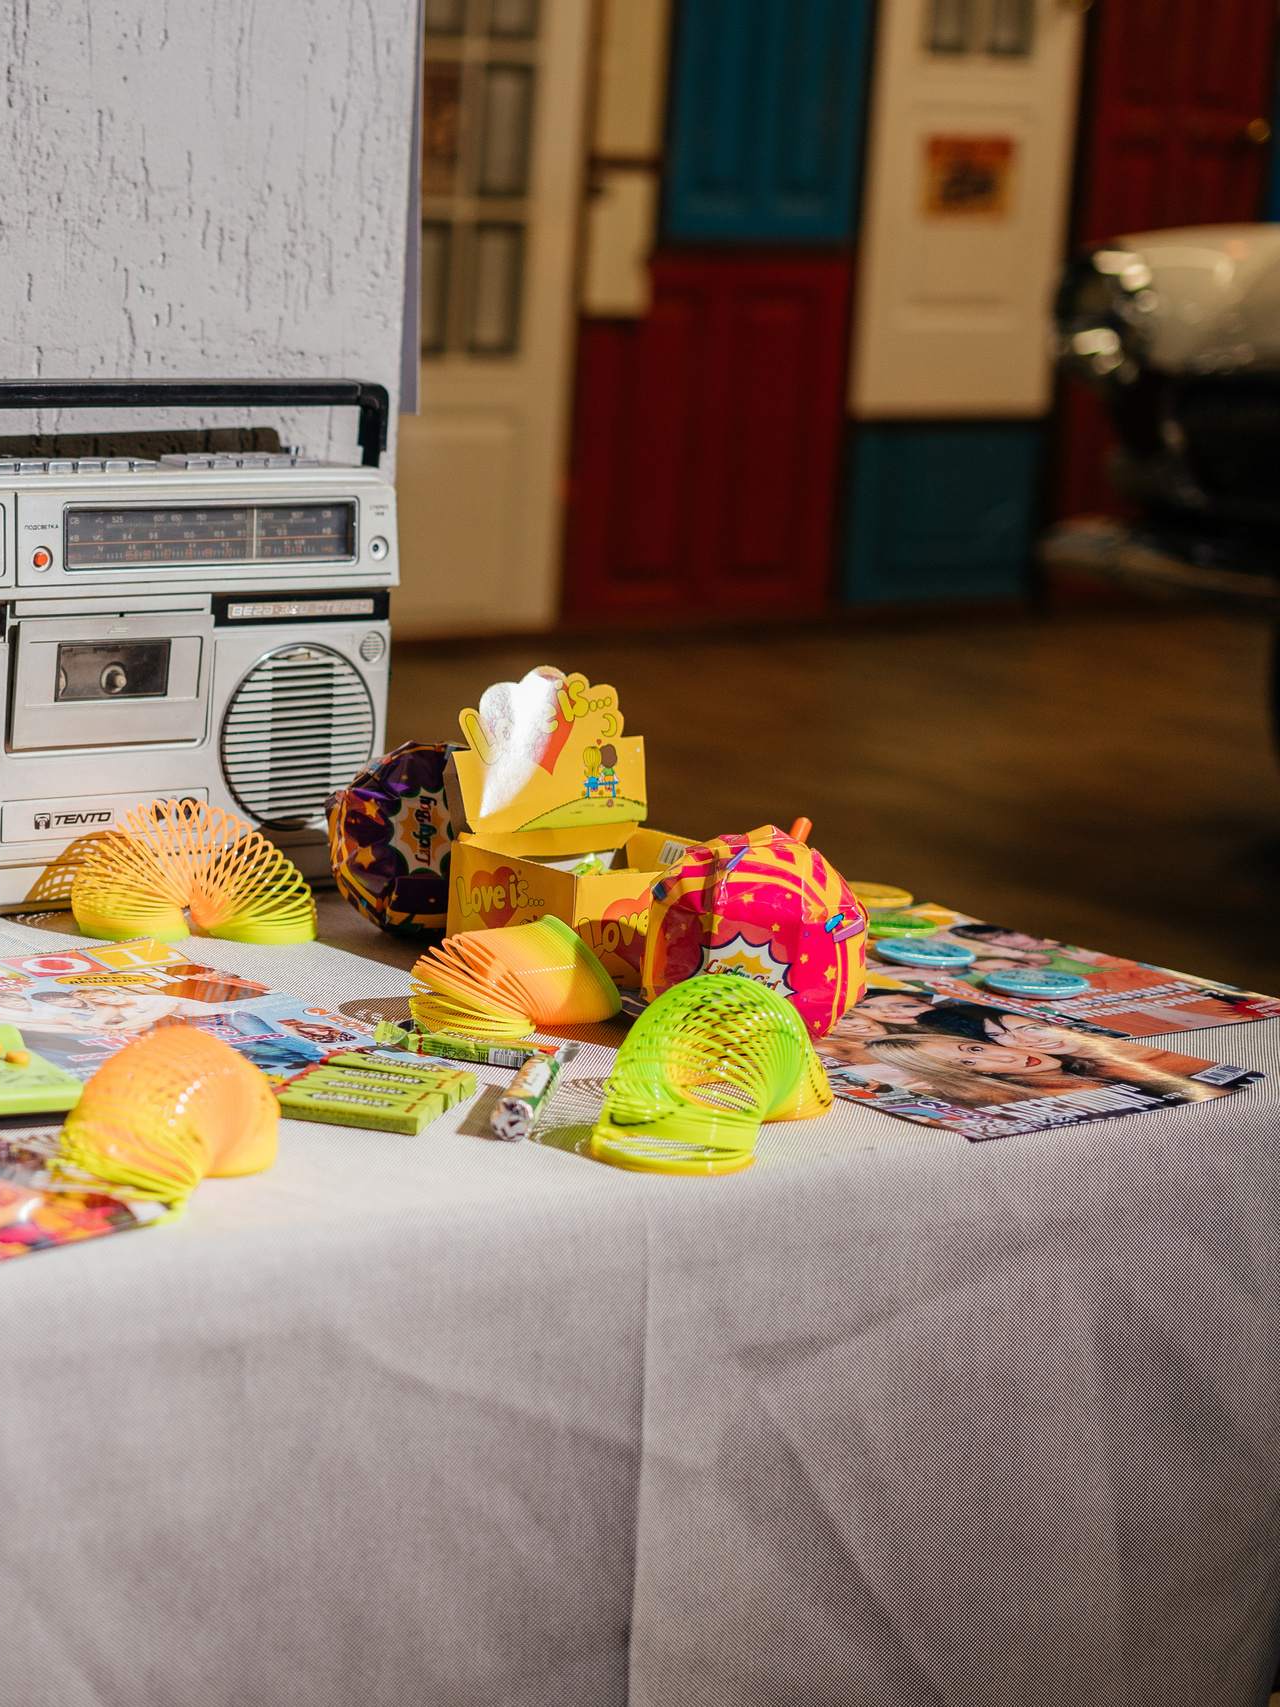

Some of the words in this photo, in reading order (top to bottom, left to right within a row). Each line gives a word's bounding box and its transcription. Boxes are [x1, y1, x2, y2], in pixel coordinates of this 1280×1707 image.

[54, 812, 111, 825] TENTO
[414, 795, 437, 822] Boy
[455, 876, 506, 918] Love
[578, 908, 649, 959] Love
